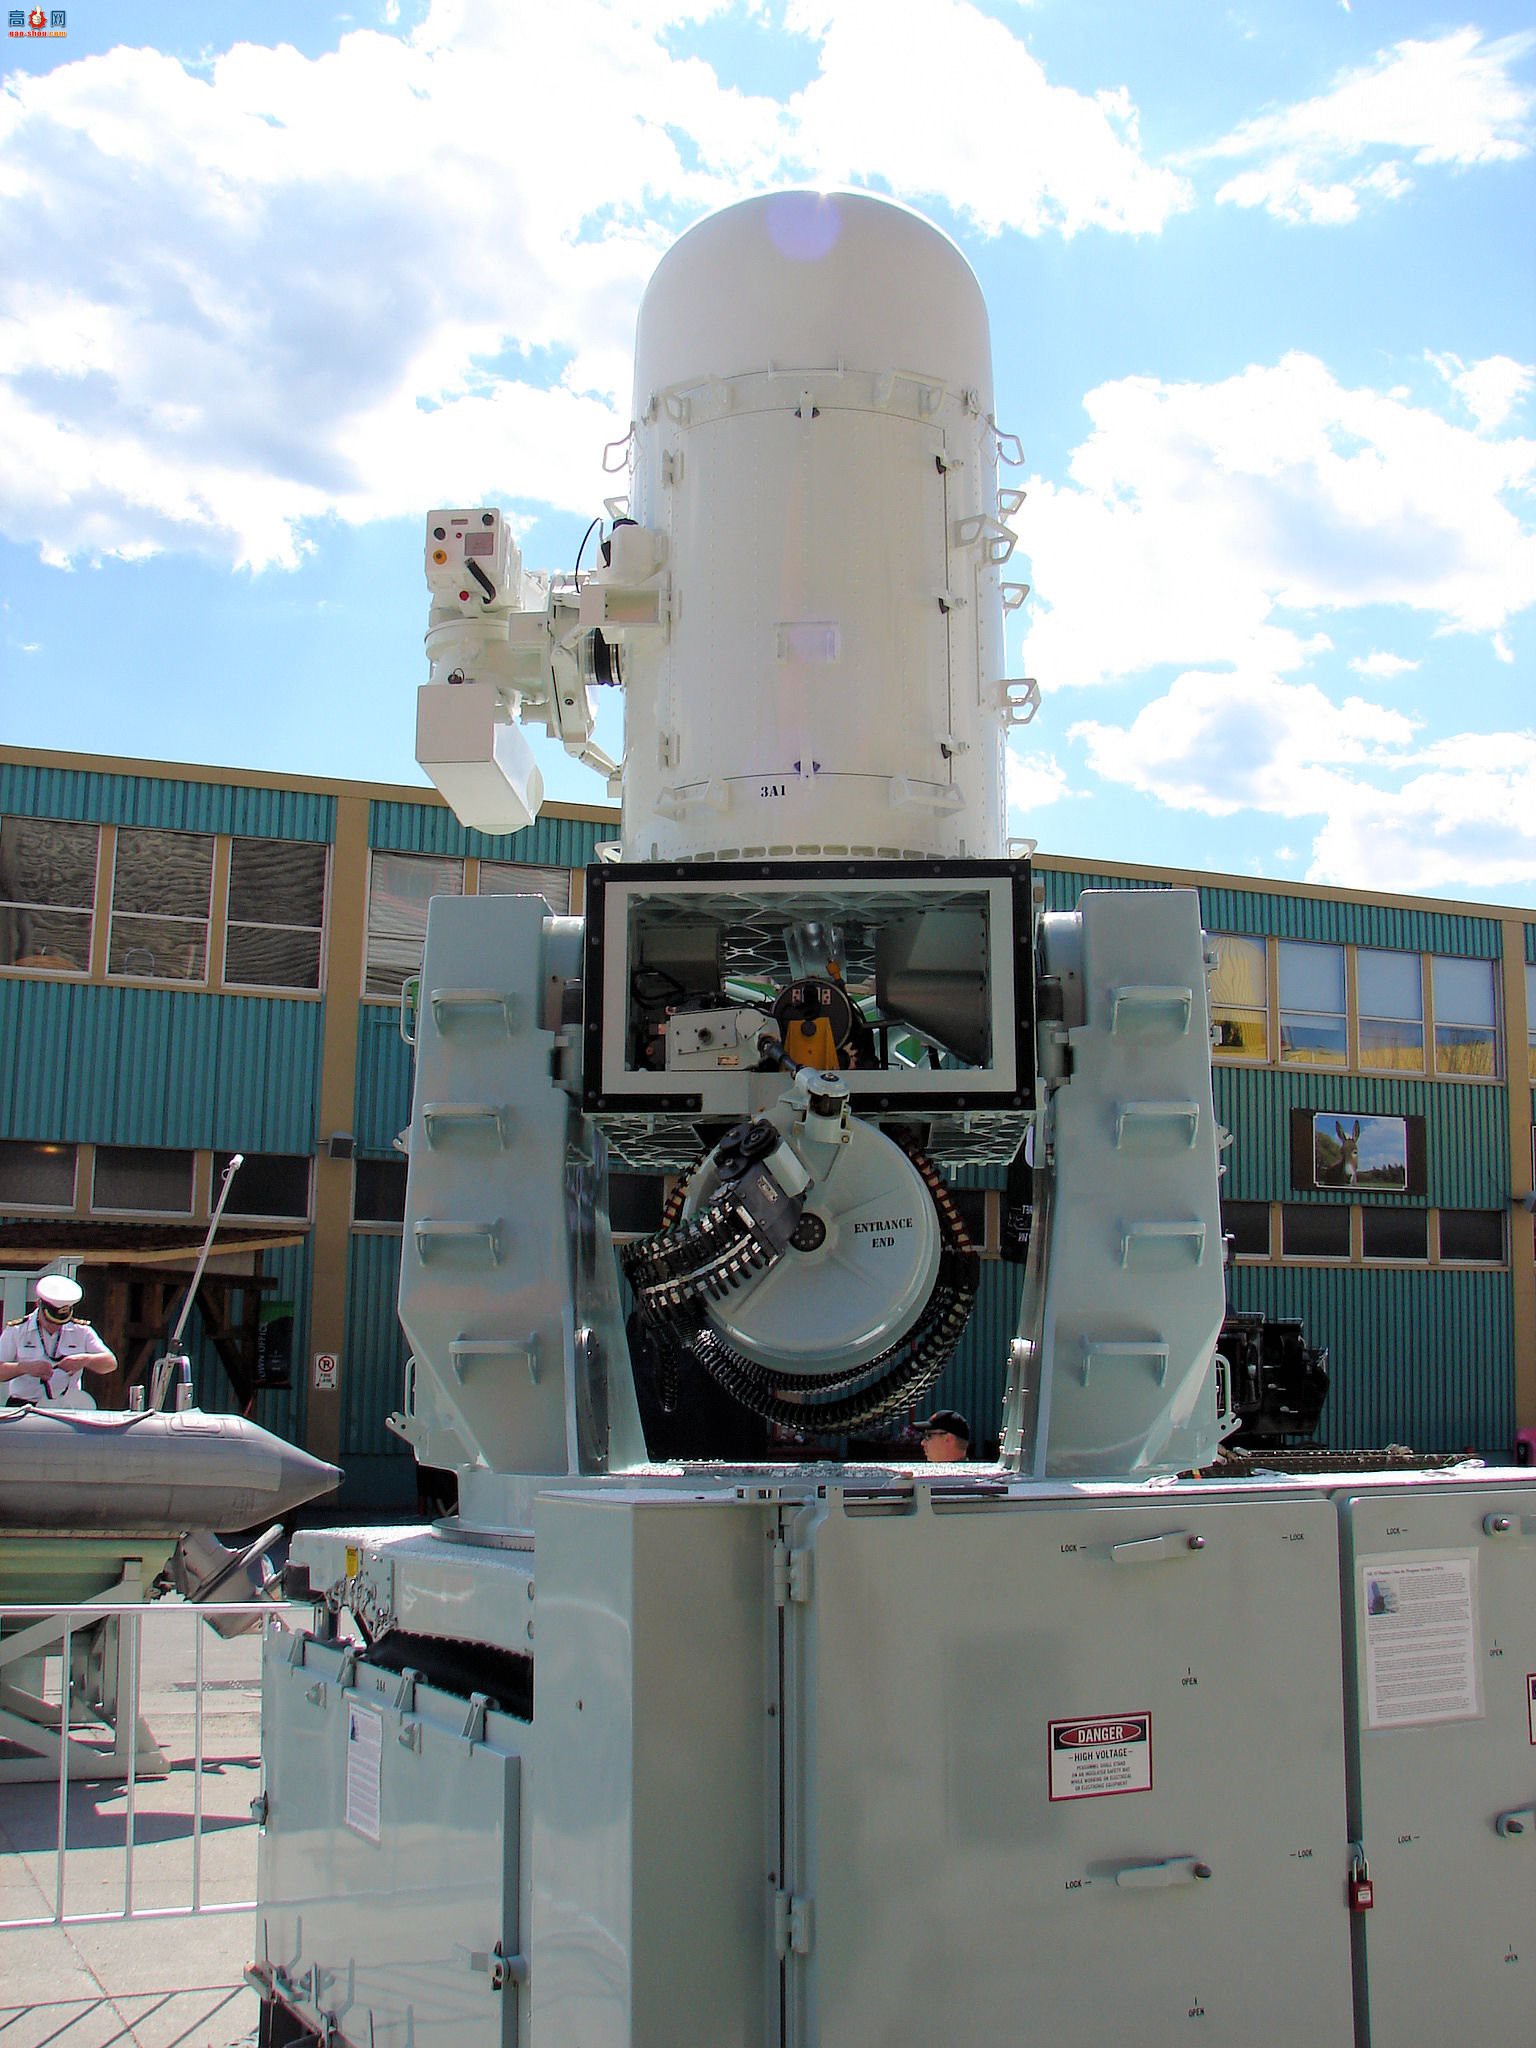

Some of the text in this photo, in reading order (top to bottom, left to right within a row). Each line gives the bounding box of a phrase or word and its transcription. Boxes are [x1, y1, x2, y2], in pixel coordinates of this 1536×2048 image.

[761, 785, 785, 797] 3A1
[854, 1218, 913, 1233] ENTRANCE
[872, 1237, 895, 1248] END
[1061, 1544, 1077, 1552] LOCK
[1181, 1677, 1197, 1685] OPEN
[1078, 1726, 1123, 1743] DANGER
[1074, 1748, 1127, 1762] HIGH VOLTAGE
[1398, 1835, 1411, 1844] LOCK
[1298, 1848, 1313, 1857] LOCK
[1065, 1880, 1082, 1889] LOCK
[1188, 2007, 1204, 2017] OPEN
